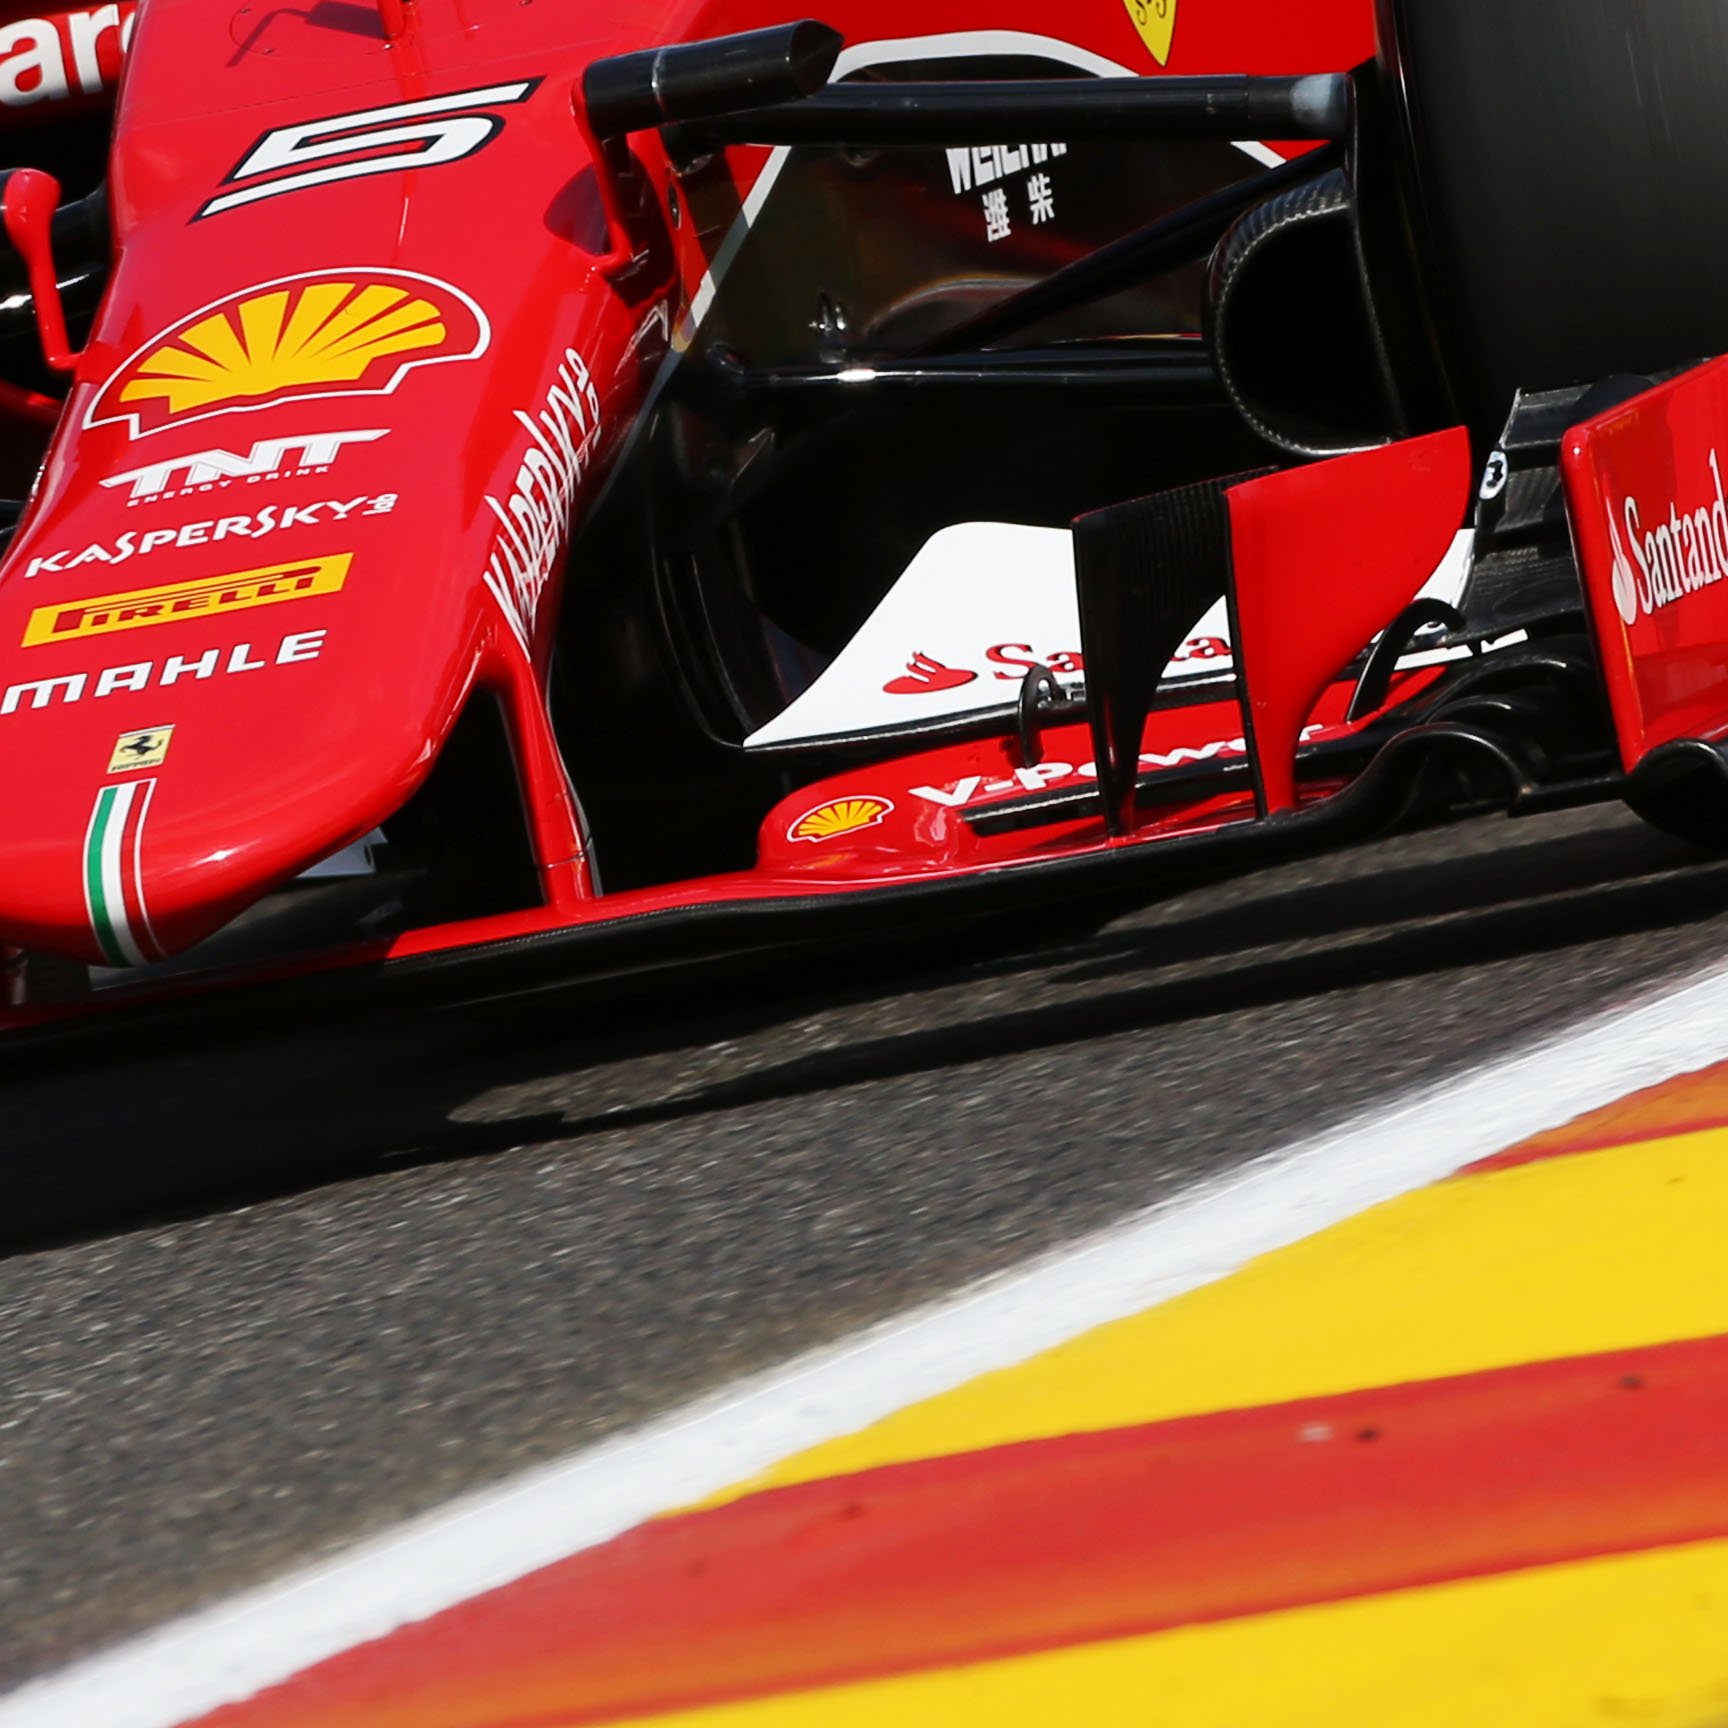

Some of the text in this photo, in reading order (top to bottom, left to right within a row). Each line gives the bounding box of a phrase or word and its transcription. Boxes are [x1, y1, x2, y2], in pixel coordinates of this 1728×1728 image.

[190, 76, 545, 224] 5
[99, 429, 392, 499] TNT
[127, 465, 329, 507] ENERGY DRINK
[24, 495, 369, 578] KASPERSKY
[52, 565, 323, 634] PIRELLI
[0, 629, 328, 715] MAHLE
